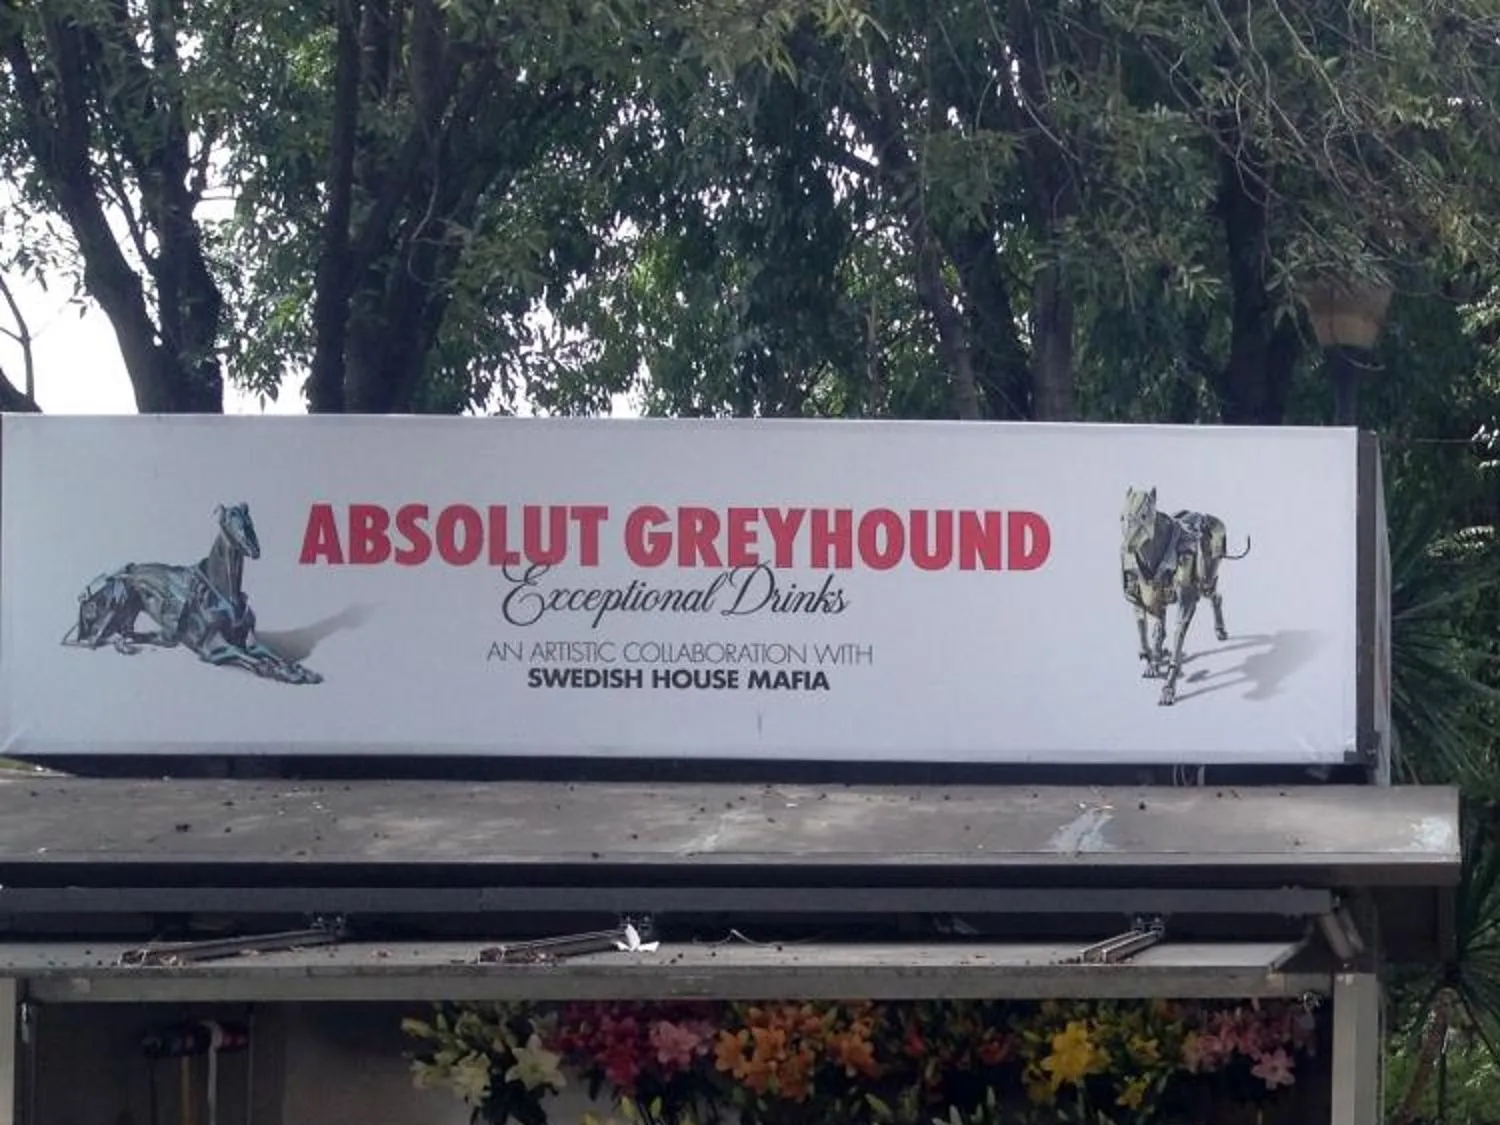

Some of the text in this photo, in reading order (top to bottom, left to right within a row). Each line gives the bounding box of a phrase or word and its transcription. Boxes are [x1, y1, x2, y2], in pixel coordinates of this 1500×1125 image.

[300, 504, 1051, 571] ABSOLUT GREYHOUND
[502, 560, 849, 629] Exceptional Drinks
[487, 641, 873, 665] AN ARTISTIC COLLABORATION WITH
[527, 667, 831, 691] SWEDISH HOUSE MAFIA
